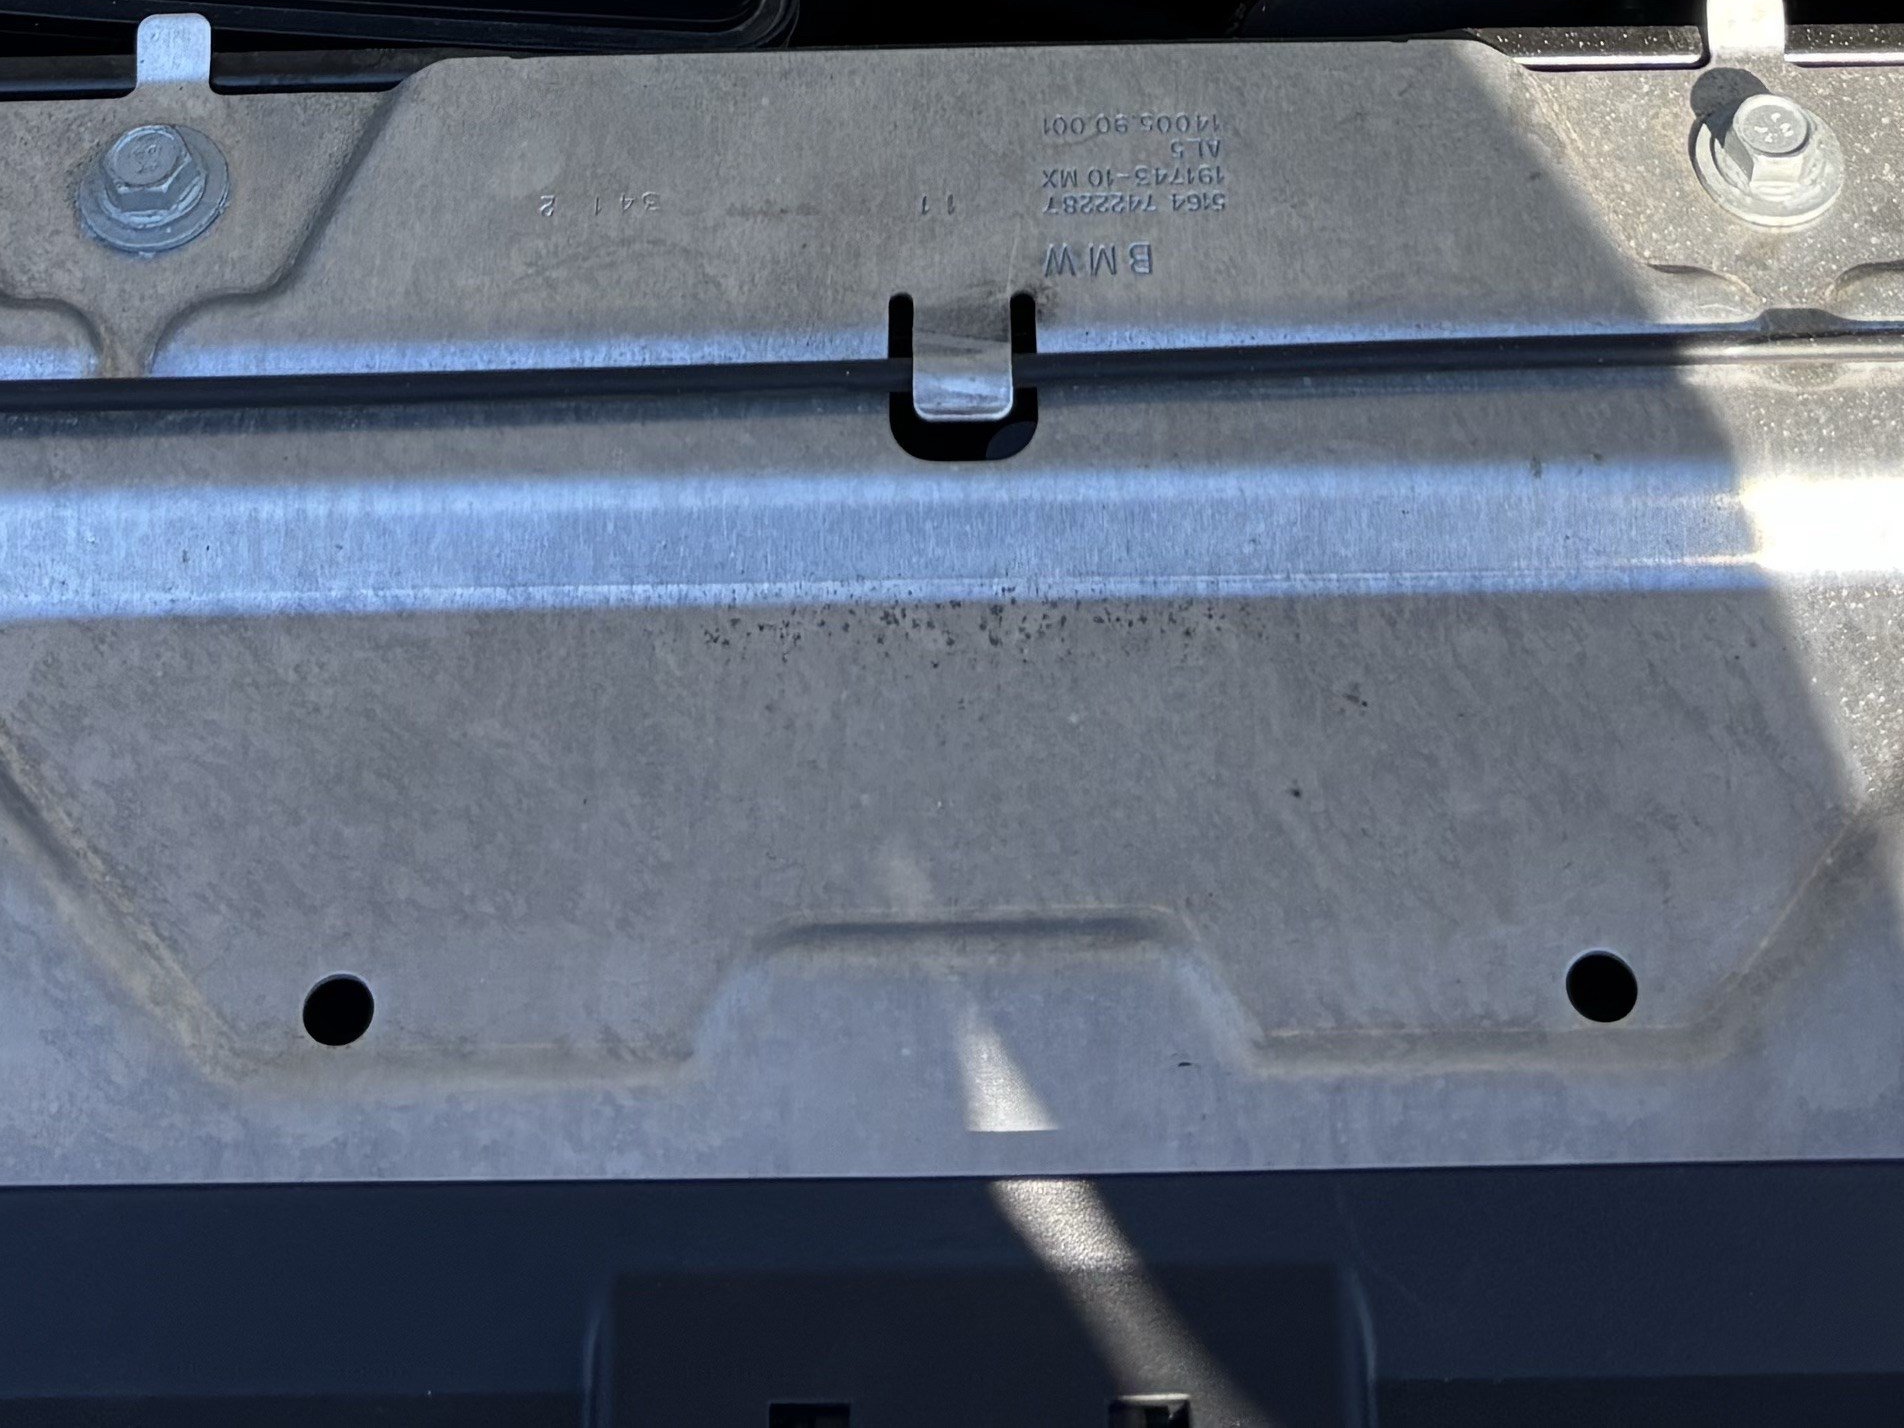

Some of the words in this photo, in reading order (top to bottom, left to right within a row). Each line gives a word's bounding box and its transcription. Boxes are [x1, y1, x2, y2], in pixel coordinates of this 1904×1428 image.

[1041, 167, 1079, 190] MX
[1087, 165, 1225, 187] 191743-10
[1042, 192, 1157, 214] 7422287
[1171, 191, 1226, 213] 5164
[1043, 242, 1153, 278] BMW
